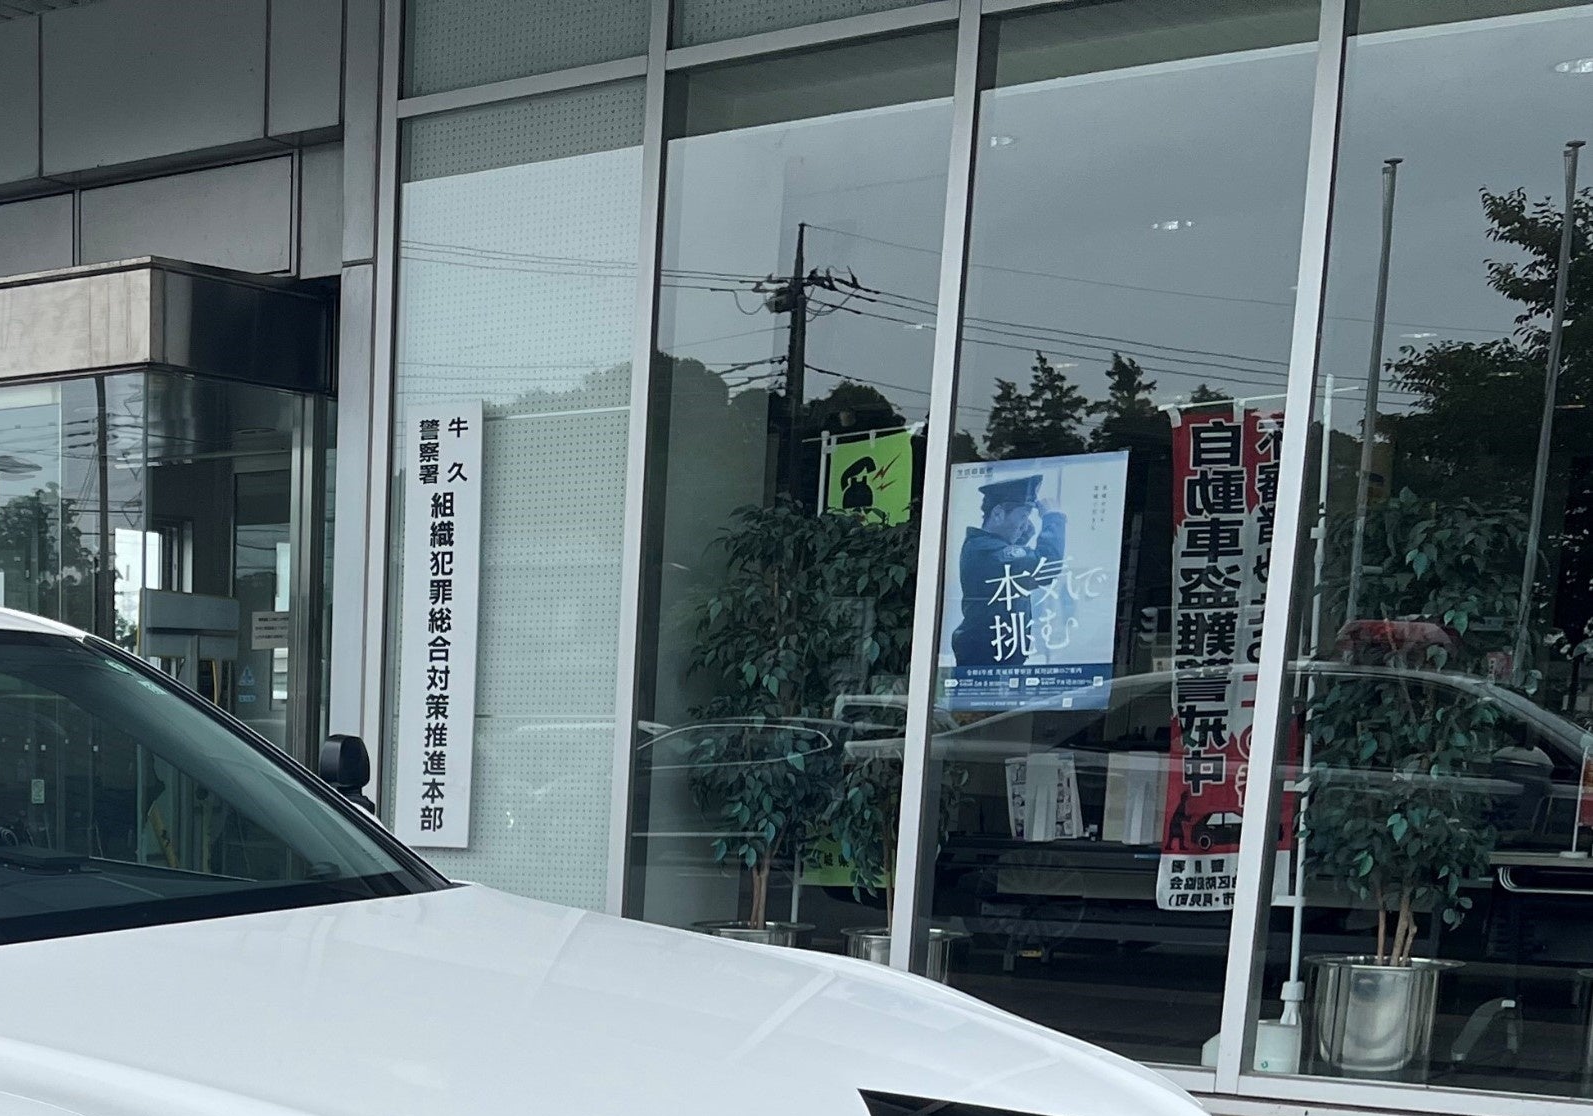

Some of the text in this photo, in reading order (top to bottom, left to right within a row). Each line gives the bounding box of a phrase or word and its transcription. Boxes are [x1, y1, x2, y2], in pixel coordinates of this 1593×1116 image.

[418, 418, 440, 486] 警察署
[447, 416, 469, 483] 牛久
[985, 556, 1107, 612] 本気で
[419, 491, 455, 833] 組織犯罪総合対策推進本部
[989, 611, 1079, 662] 挑む
